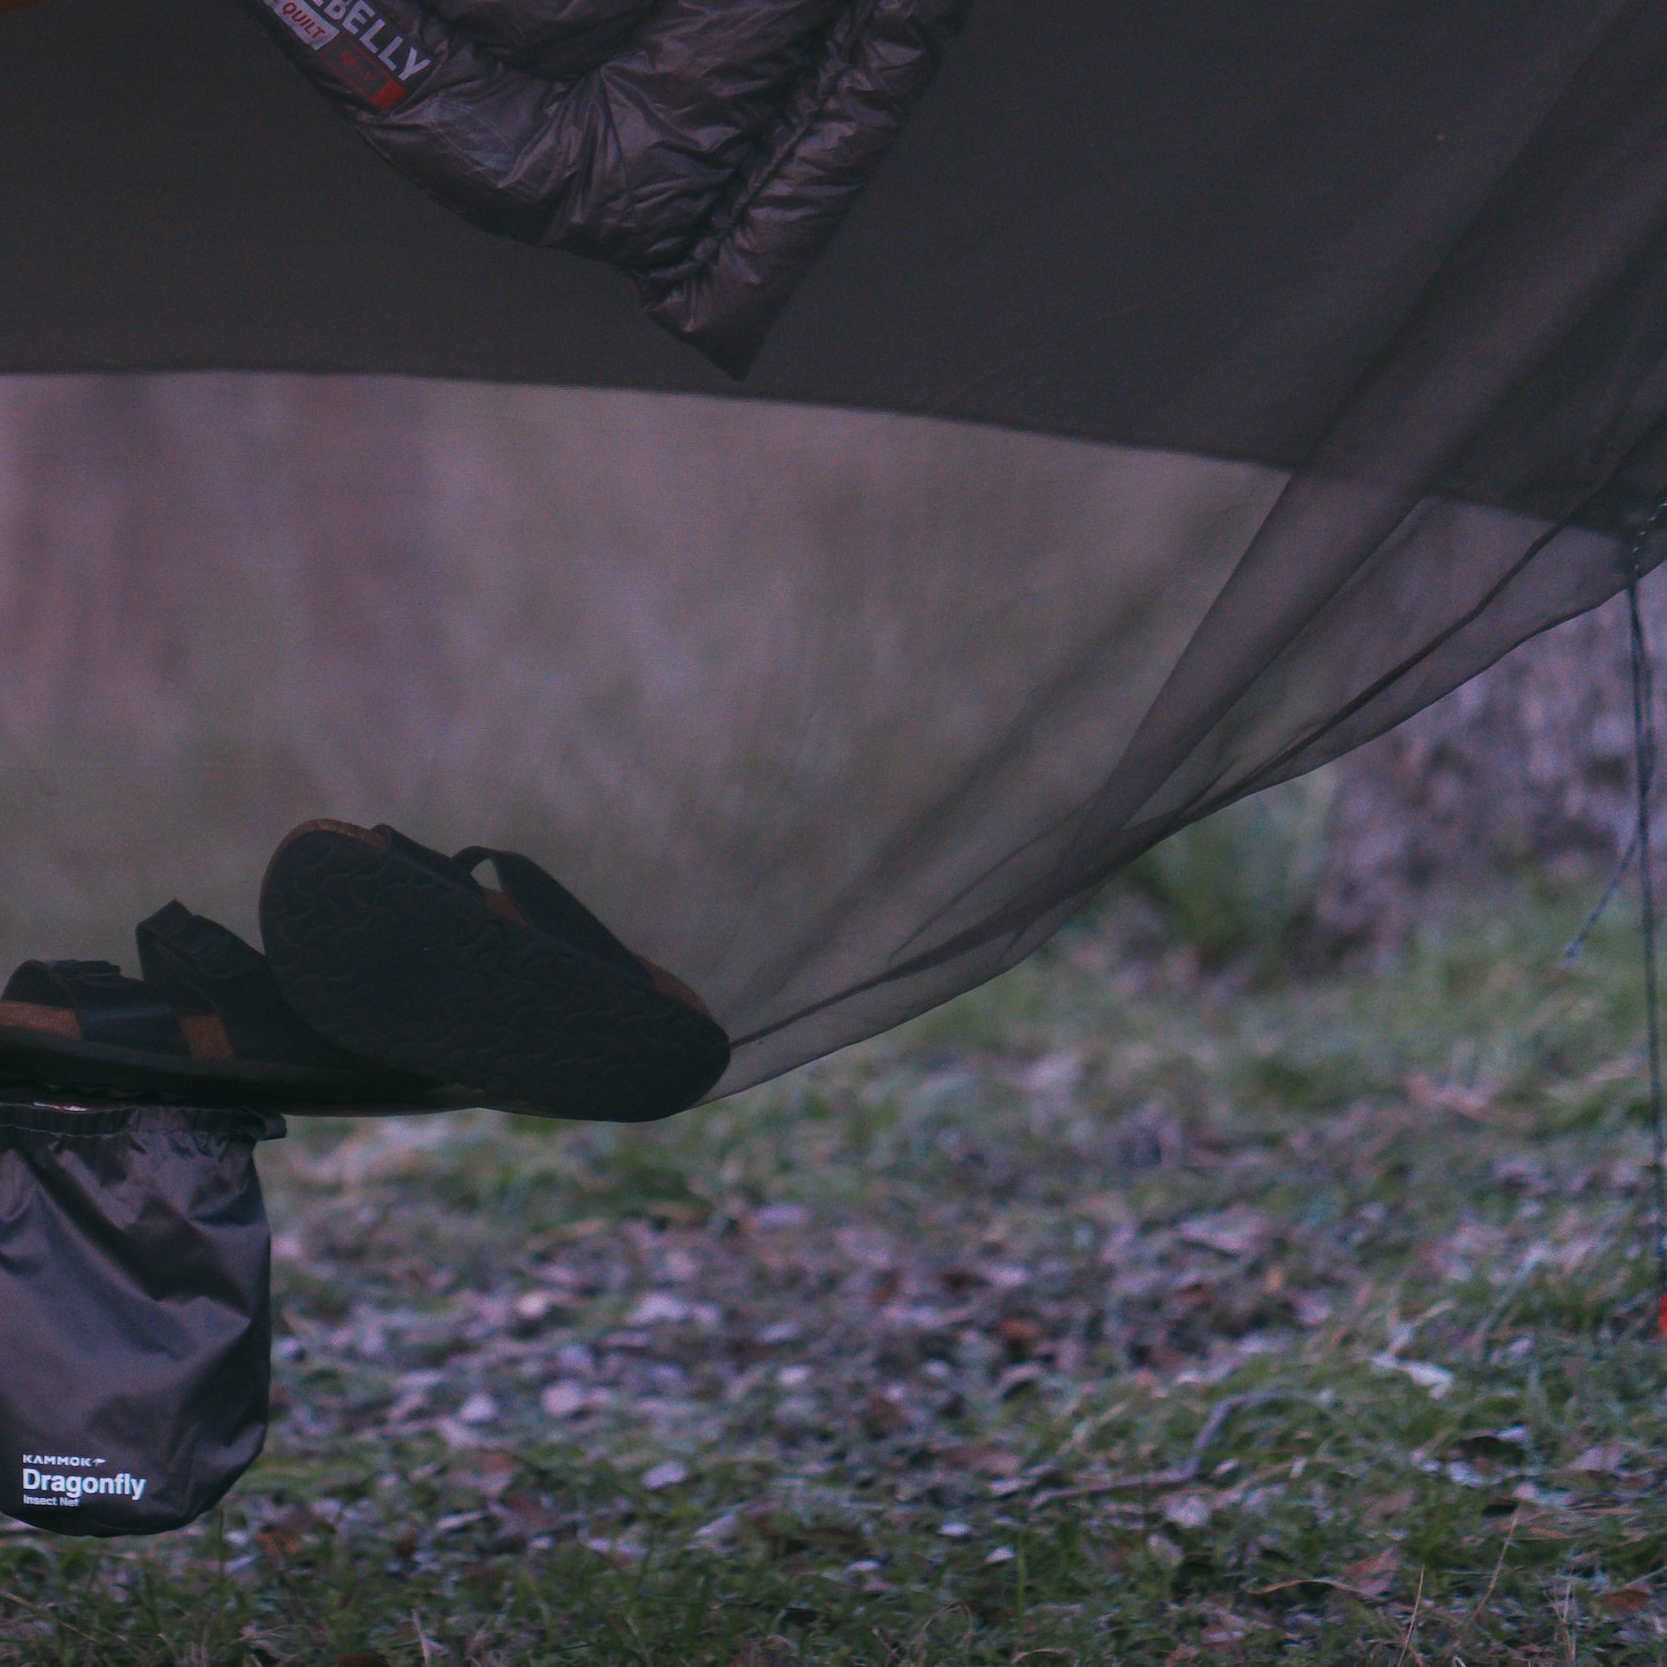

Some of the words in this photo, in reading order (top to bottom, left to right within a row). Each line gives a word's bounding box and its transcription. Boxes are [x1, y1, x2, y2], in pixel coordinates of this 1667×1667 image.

[282, 1, 327, 39] QUILT
[23, 1454, 92, 1467] KAMMOK
[23, 1468, 147, 1501] Dragonfly
[23, 1494, 58, 1506] Insect
[59, 1497, 80, 1507] Net
